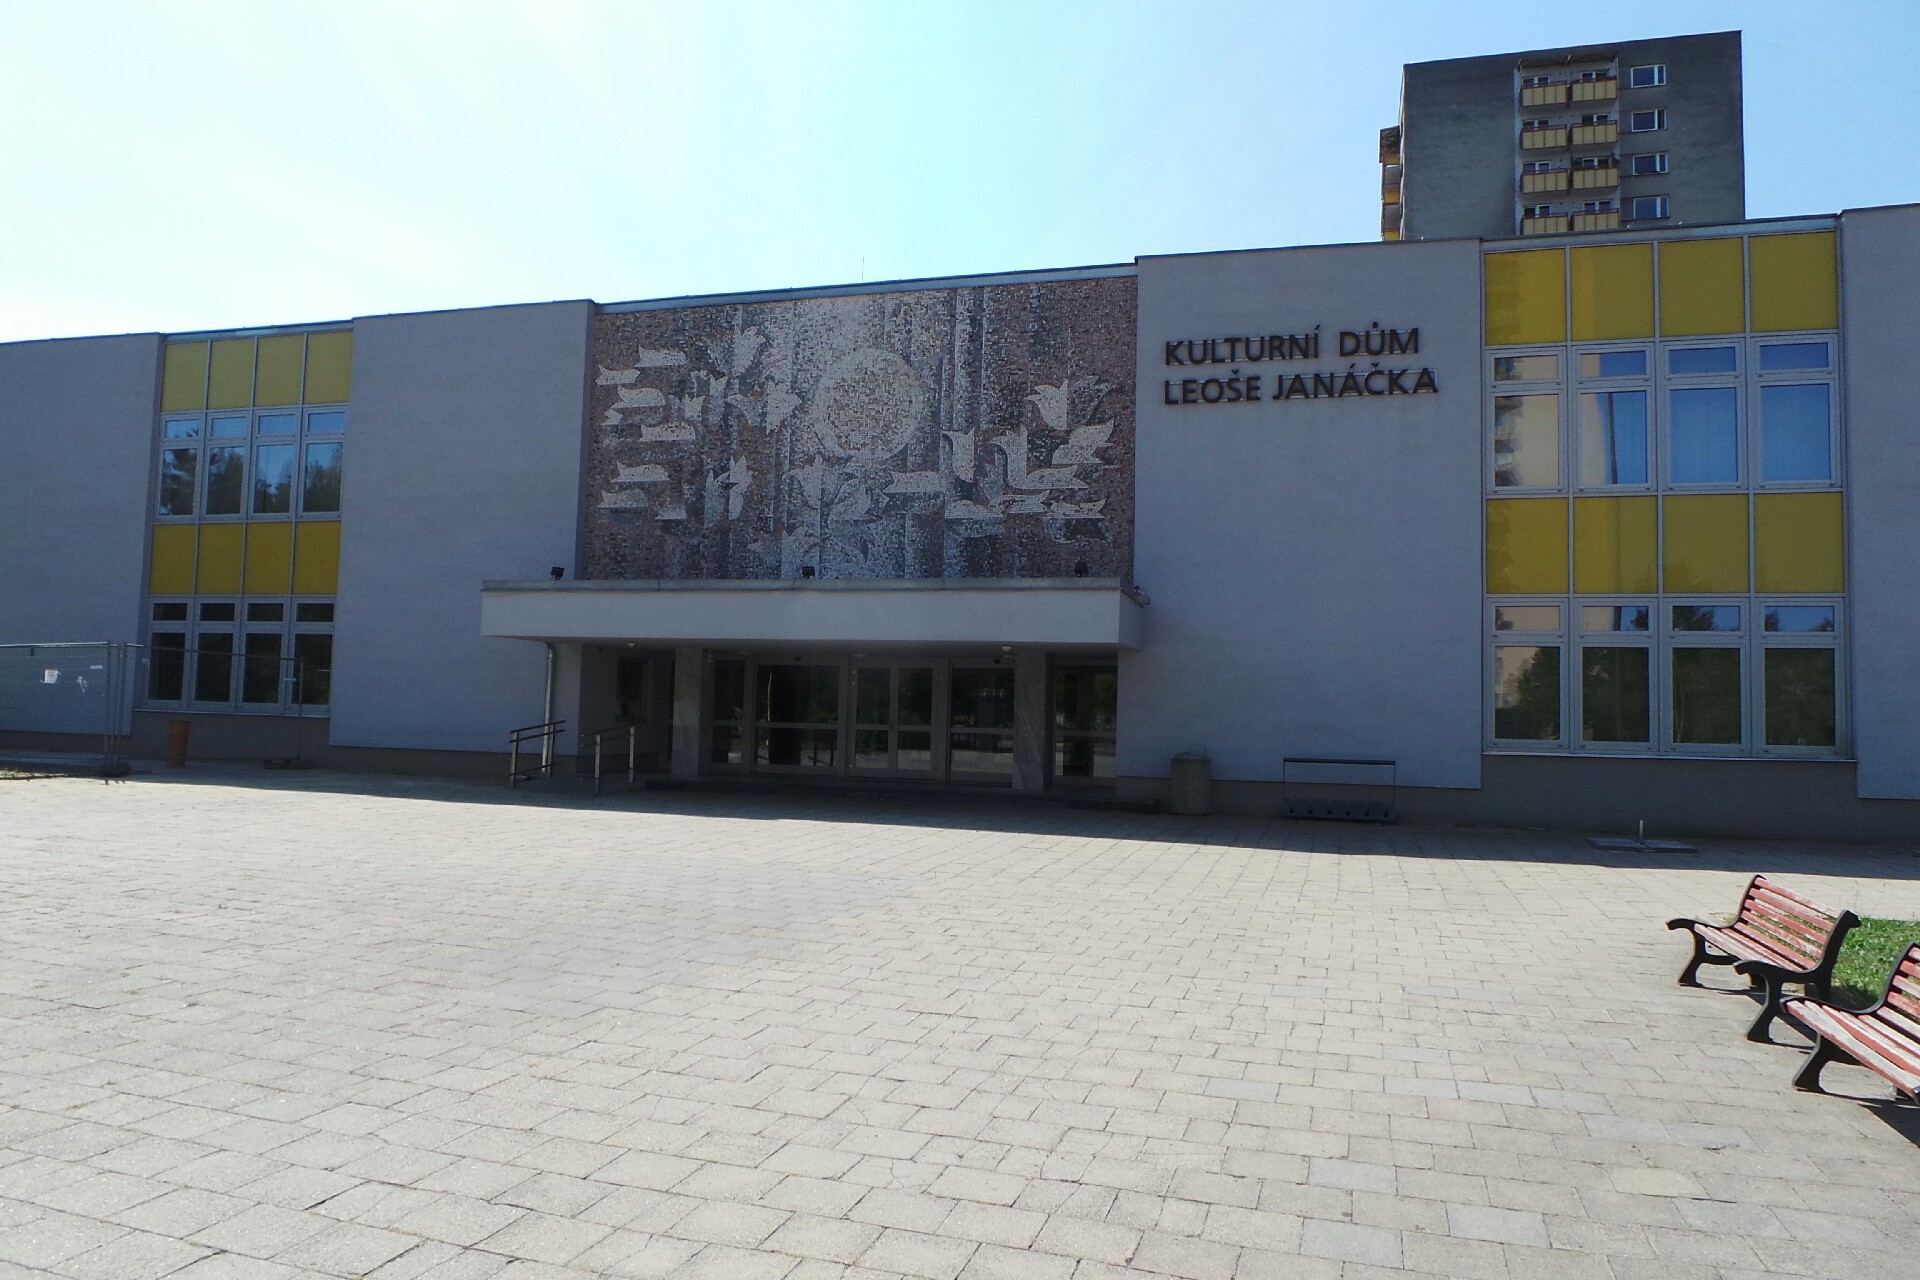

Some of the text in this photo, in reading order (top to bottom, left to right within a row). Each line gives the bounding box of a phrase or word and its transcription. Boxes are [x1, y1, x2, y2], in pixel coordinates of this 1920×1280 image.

[1165, 320, 1419, 365] KULTURNÍ DŮM
[1164, 362, 1438, 404] LEOŠE JANÁČKA
